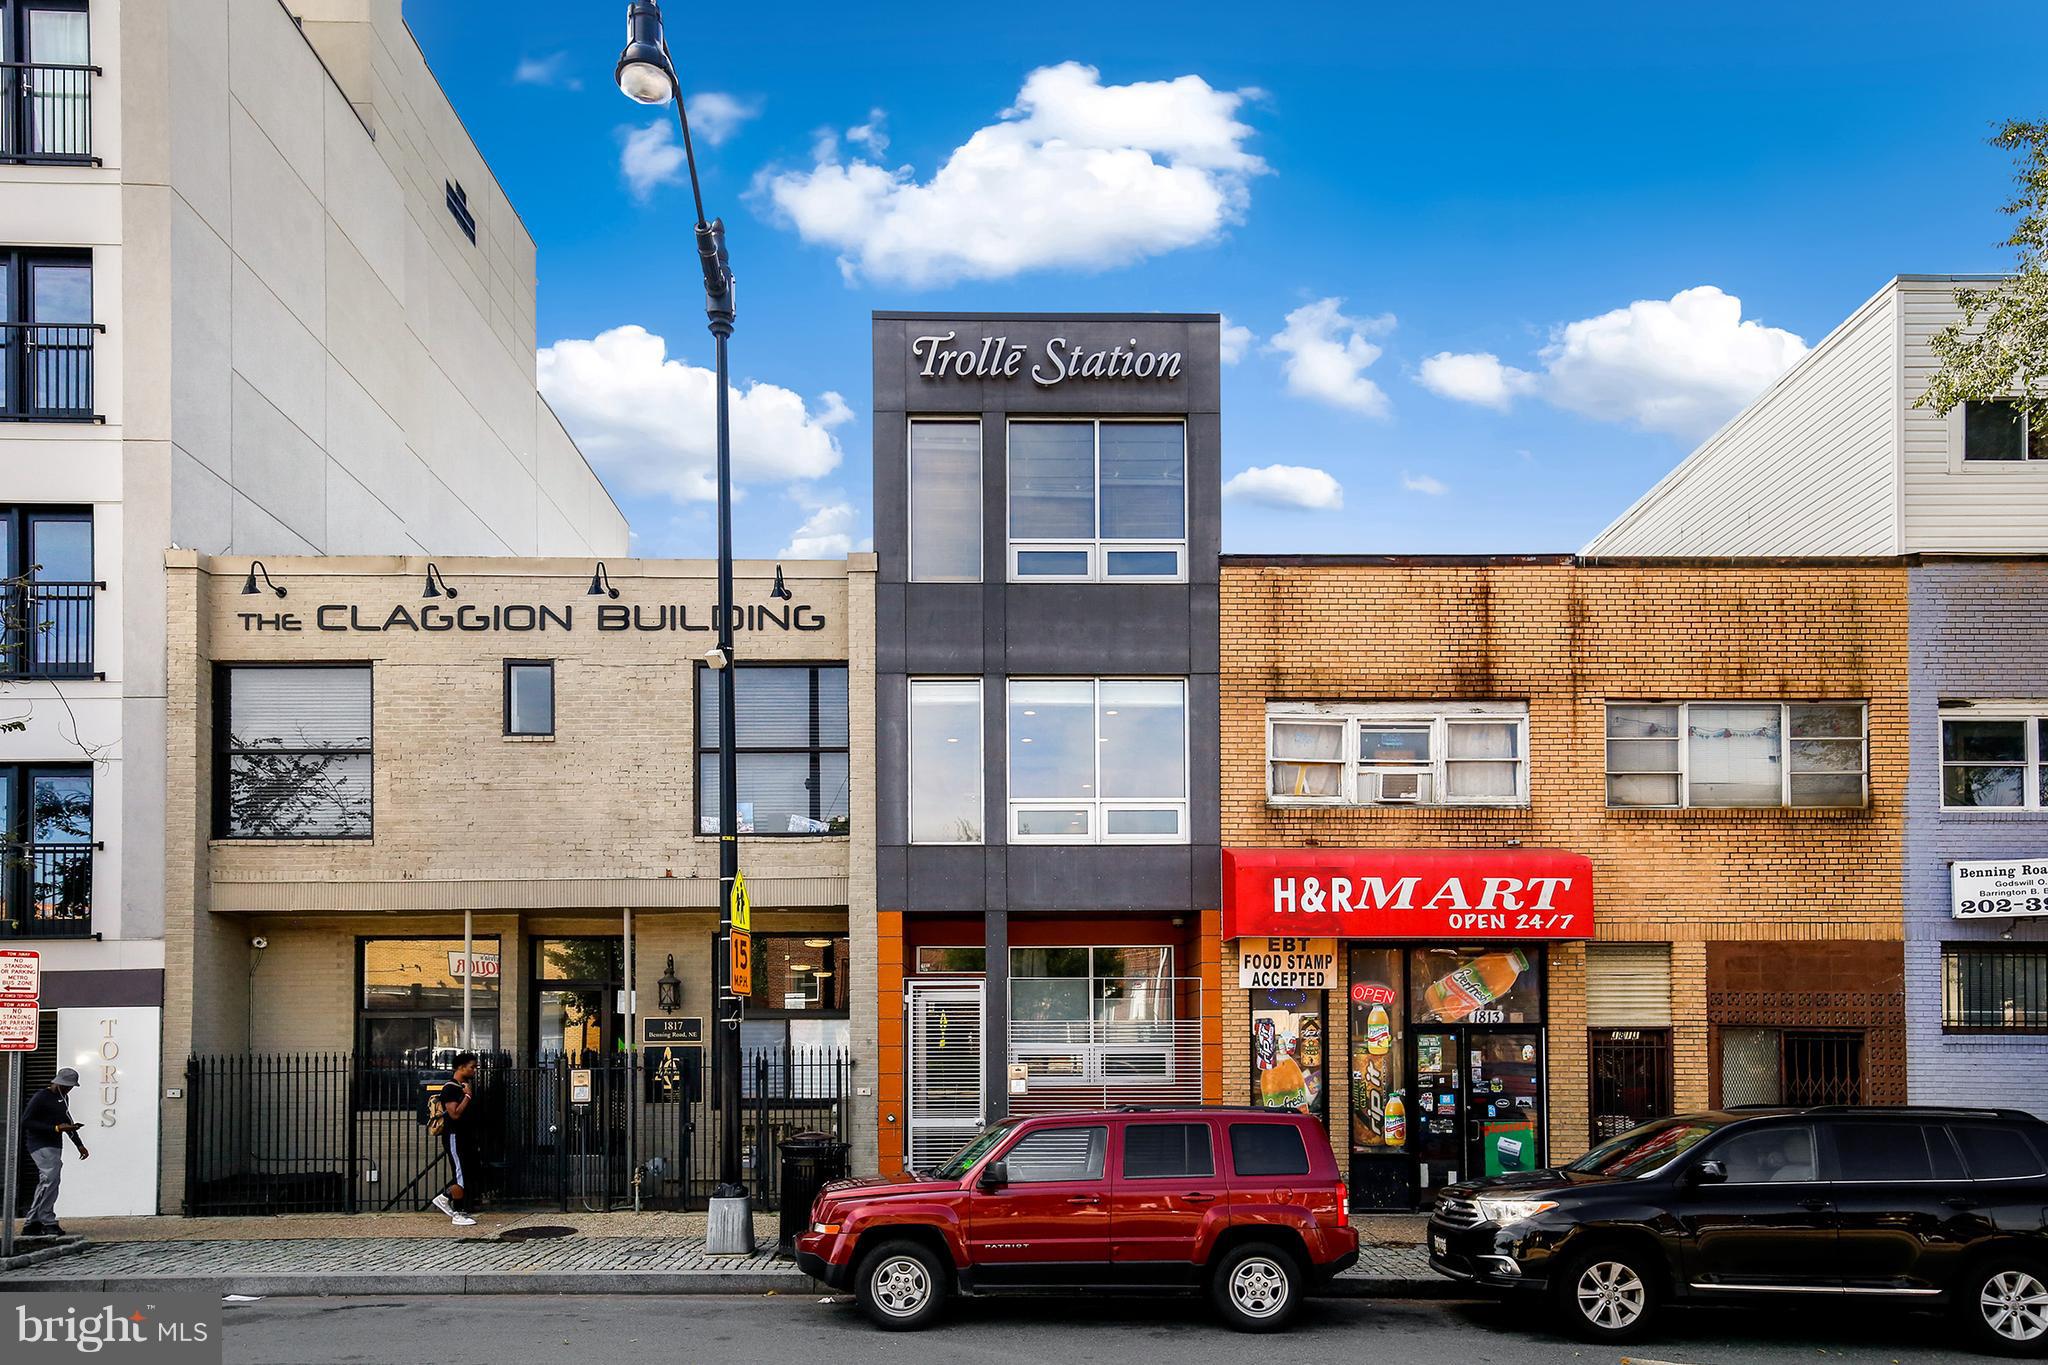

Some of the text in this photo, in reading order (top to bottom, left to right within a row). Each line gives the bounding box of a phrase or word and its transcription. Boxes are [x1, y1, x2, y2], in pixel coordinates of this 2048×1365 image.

[1032, 337, 1182, 385] Station
[237, 604, 826, 631] THE CLAGGION BUILDING
[1960, 867, 2016, 879] Benning
[1273, 876, 1572, 913] H&R MART
[1979, 889, 2027, 897] Barrington
[1961, 897, 2048, 914] 202-3
[1449, 913, 1574, 930] OPEN 24/7
[1268, 937, 1311, 952] EBT
[735, 938, 748, 970] 15
[1244, 954, 1333, 969] FOOD STAMP
[1252, 972, 1325, 987] ACCEPTED
[1353, 986, 1396, 1004] OPEN
[1473, 1010, 1500, 1022] 1813
[664, 1021, 683, 1031] 1817
[99, 1018, 119, 1128] TORUS
[1365, 1060, 1384, 1136] rip it
